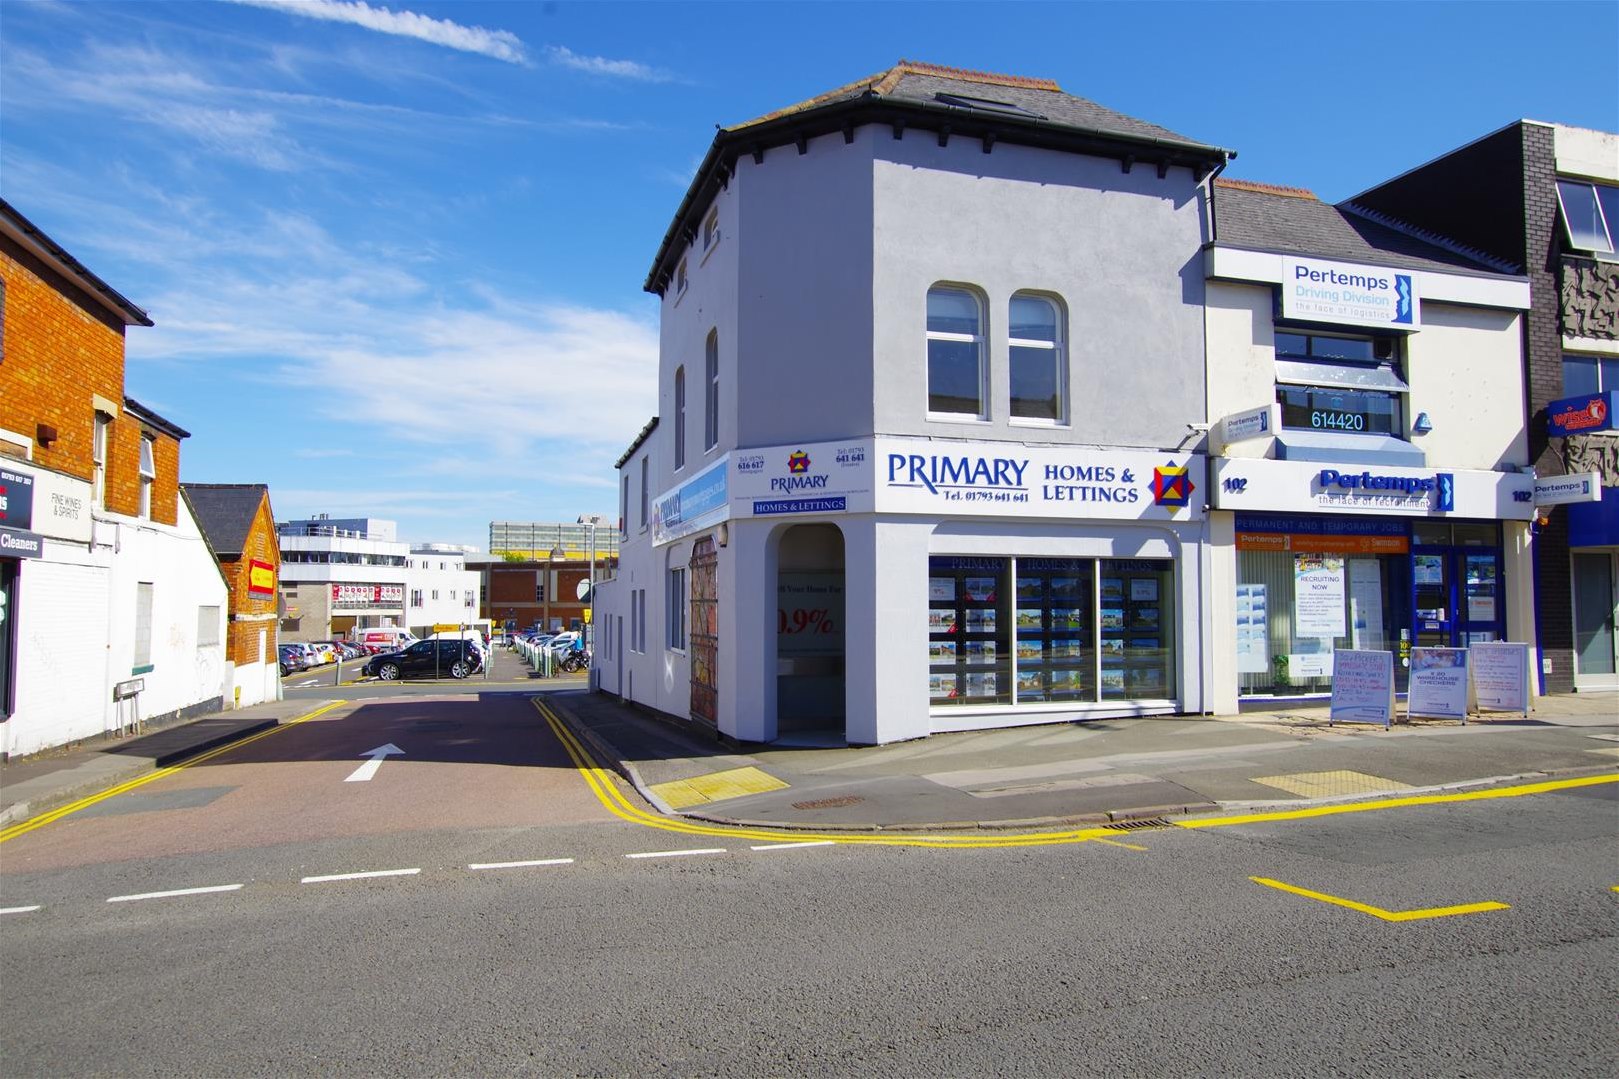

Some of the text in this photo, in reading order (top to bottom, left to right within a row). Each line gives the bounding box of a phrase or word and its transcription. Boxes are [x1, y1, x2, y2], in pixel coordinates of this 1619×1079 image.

[1295, 264, 1389, 291] Pertemps
[1295, 285, 1390, 306] Driving Division
[1295, 302, 1311, 312] the
[1314, 304, 1334, 314] face
[1350, 307, 1390, 321] logistics
[1228, 415, 1259, 427] Pertemps
[1312, 411, 1363, 430] 614420
[836, 453, 864, 463] 641 641
[738, 461, 764, 470] 616 617
[888, 453, 1029, 494] PRIMARY
[1045, 464, 1135, 484] HOMES &
[771, 475, 828, 493] PRIMARY
[1225, 477, 1248, 491] 102
[1320, 469, 1434, 494] Pertemps
[1535, 483, 1580, 492] Pertemps
[51, 493, 81, 509] FINE WINES
[944, 490, 1029, 503] Tel. 01793 641 641
[1043, 485, 1138, 504] LETTINGS
[1319, 496, 1334, 504] the
[1512, 491, 1532, 502] 102
[59, 506, 78, 519] SPIRITS
[659, 490, 681, 521] PRIMARY
[756, 503, 789, 513] HOMES
[799, 500, 845, 510] LETTINGS
[1236, 520, 1404, 532] PERMANENT AND TEMPORARY JOBS
[1, 534, 38, 551] Cleaners
[1241, 535, 1282, 544] Pertemps
[951, 558, 1008, 570] PRIMARY
[1027, 560, 1067, 571] HOMES
